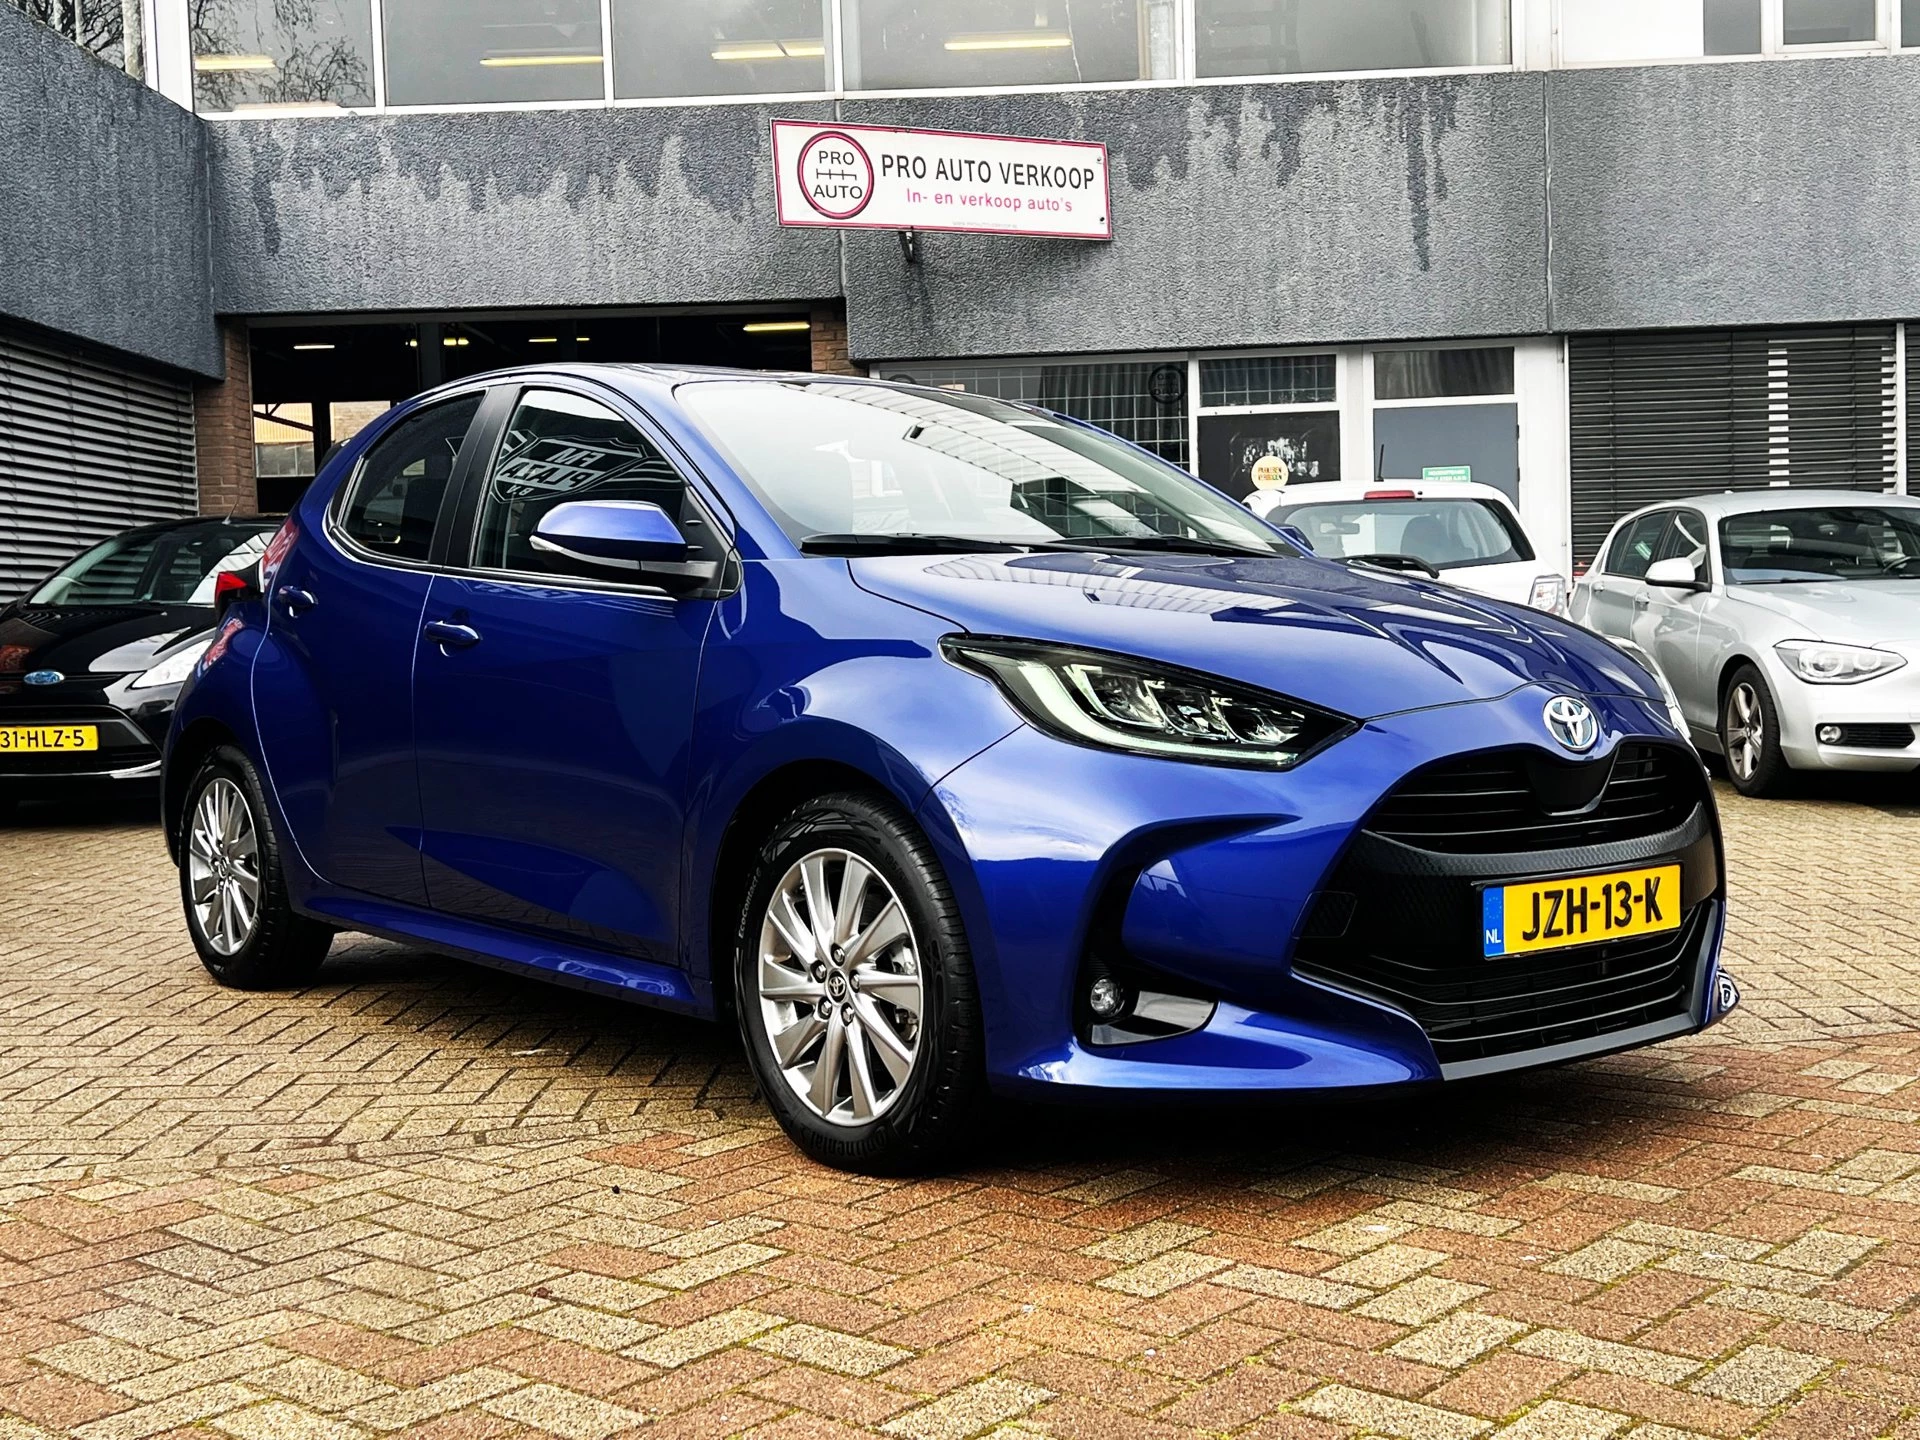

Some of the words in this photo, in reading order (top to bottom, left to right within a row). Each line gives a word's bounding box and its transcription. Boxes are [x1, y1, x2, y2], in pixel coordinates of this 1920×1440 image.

[818, 150, 855, 165] PRO
[881, 153, 926, 179] PRO
[935, 157, 992, 183] AUTO
[999, 161, 1095, 190] VERKOOP
[813, 184, 863, 199] AUTO
[907, 188, 928, 203] In-
[934, 192, 953, 205] en
[960, 193, 1022, 212] verkoop
[1027, 199, 1073, 212] auto's
[0, 730, 85, 748] 31-HLZ-5
[1522, 876, 1663, 942] JZH-13-K
[1485, 929, 1502, 945] NL
